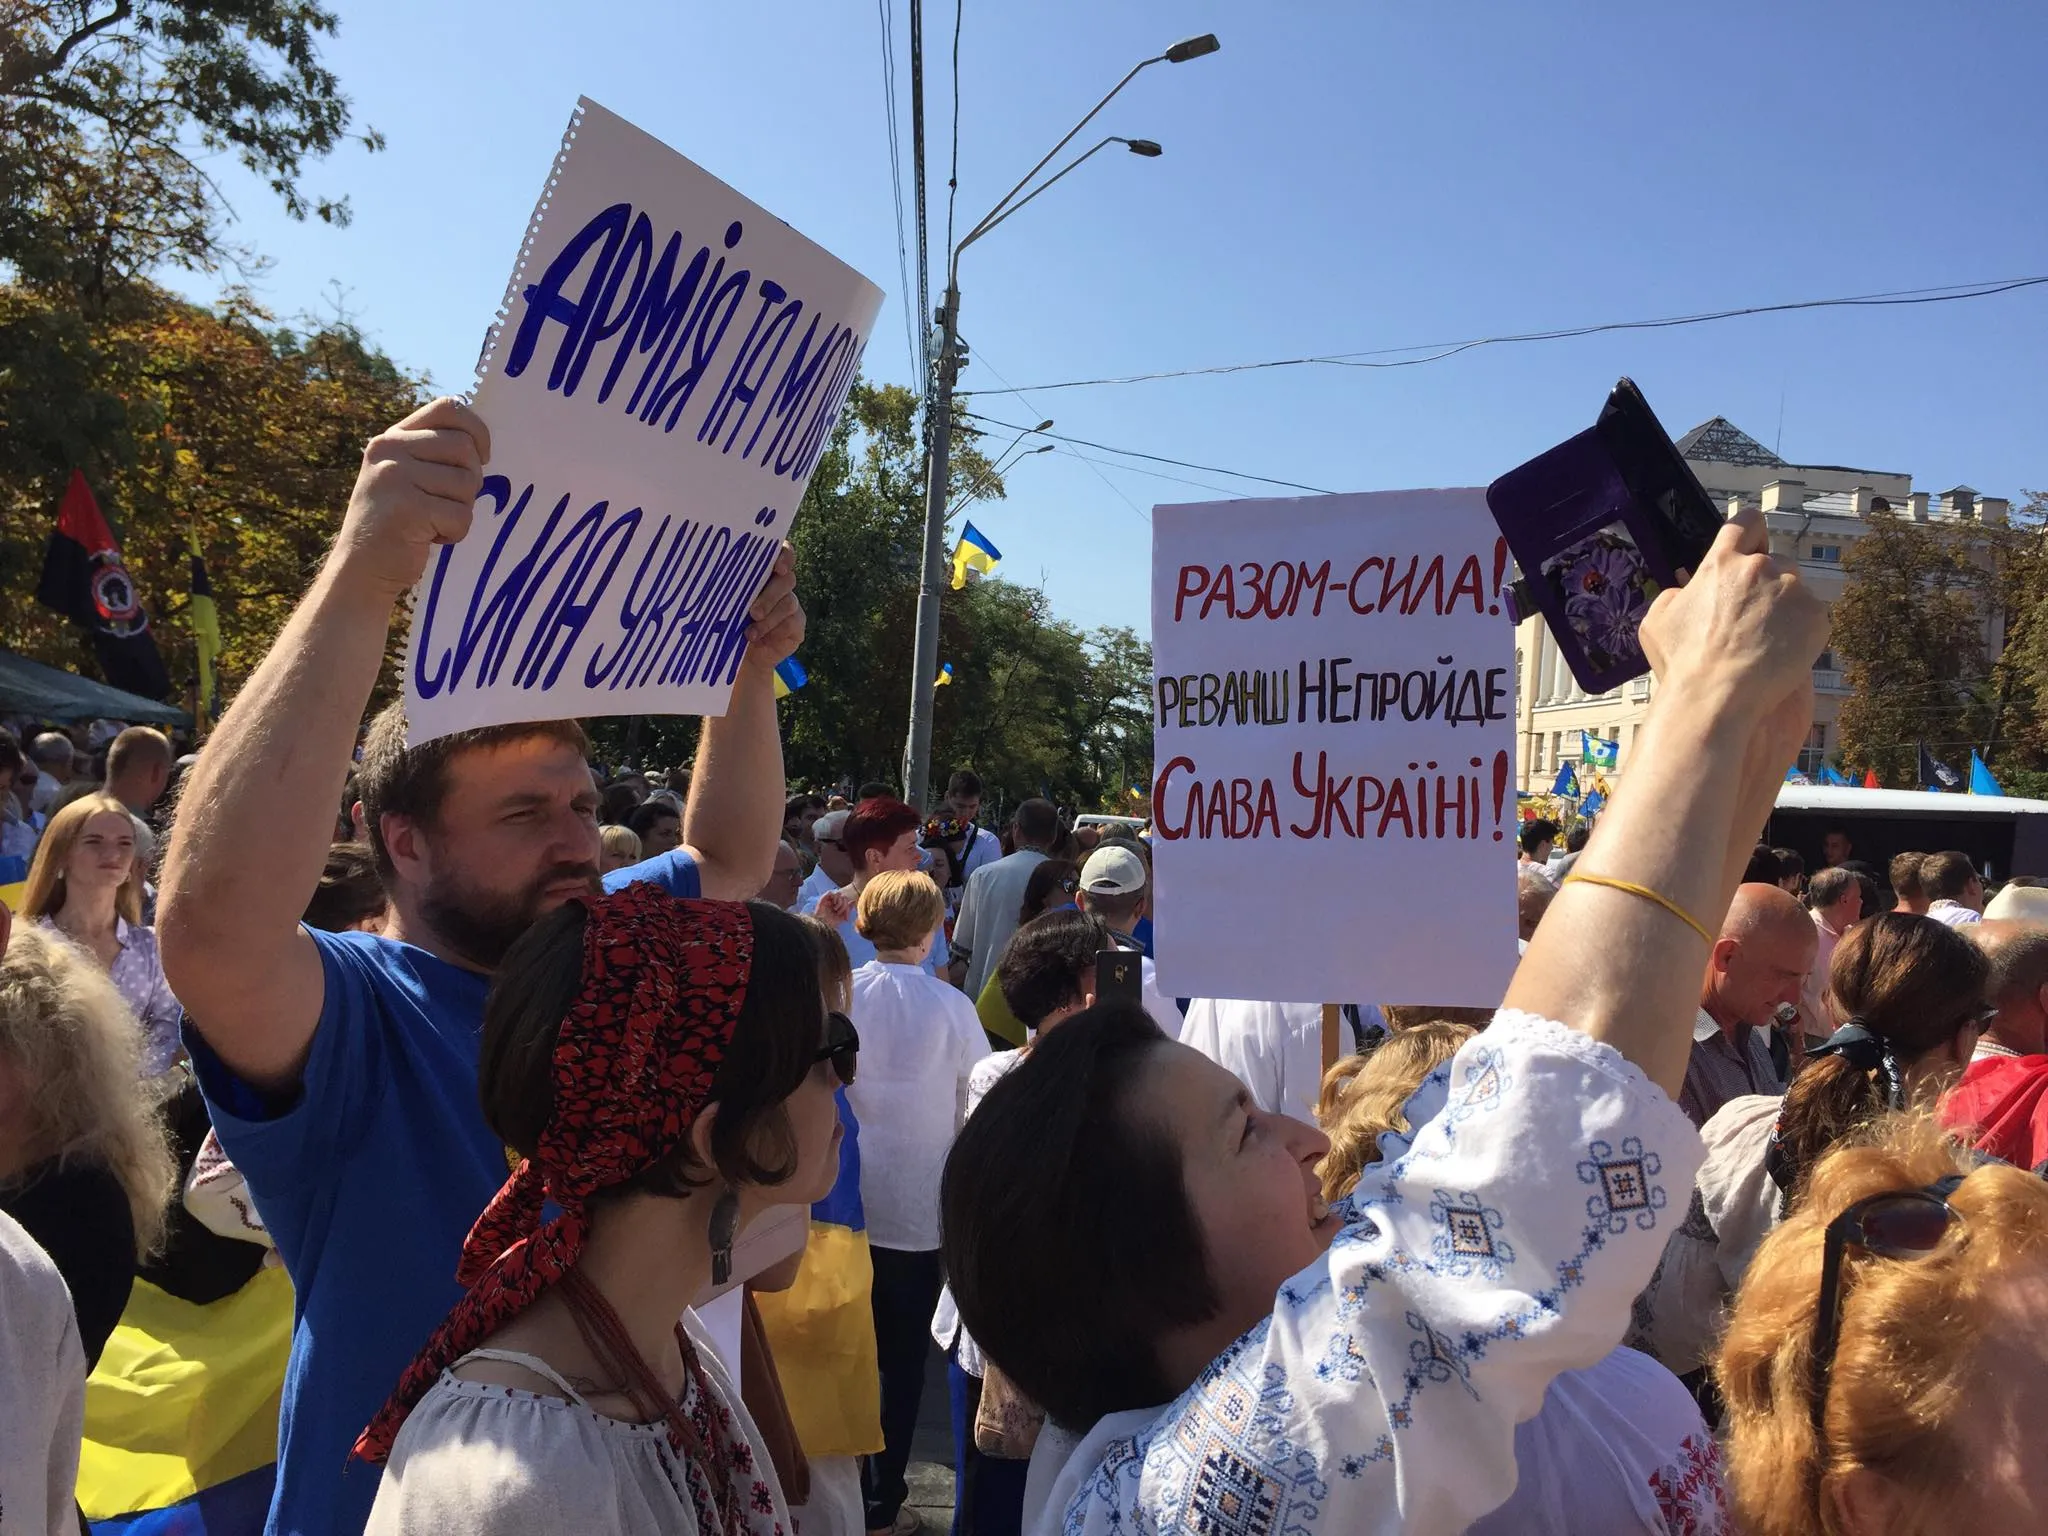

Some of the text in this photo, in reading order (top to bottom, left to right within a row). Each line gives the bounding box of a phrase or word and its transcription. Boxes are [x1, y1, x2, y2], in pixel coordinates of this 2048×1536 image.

[504, 203, 750, 434] АРМІЯ
[697, 280, 804, 455] ТА
[415, 474, 643, 700] СИЛА
[1158, 669, 1289, 729] РЕВАНШ
